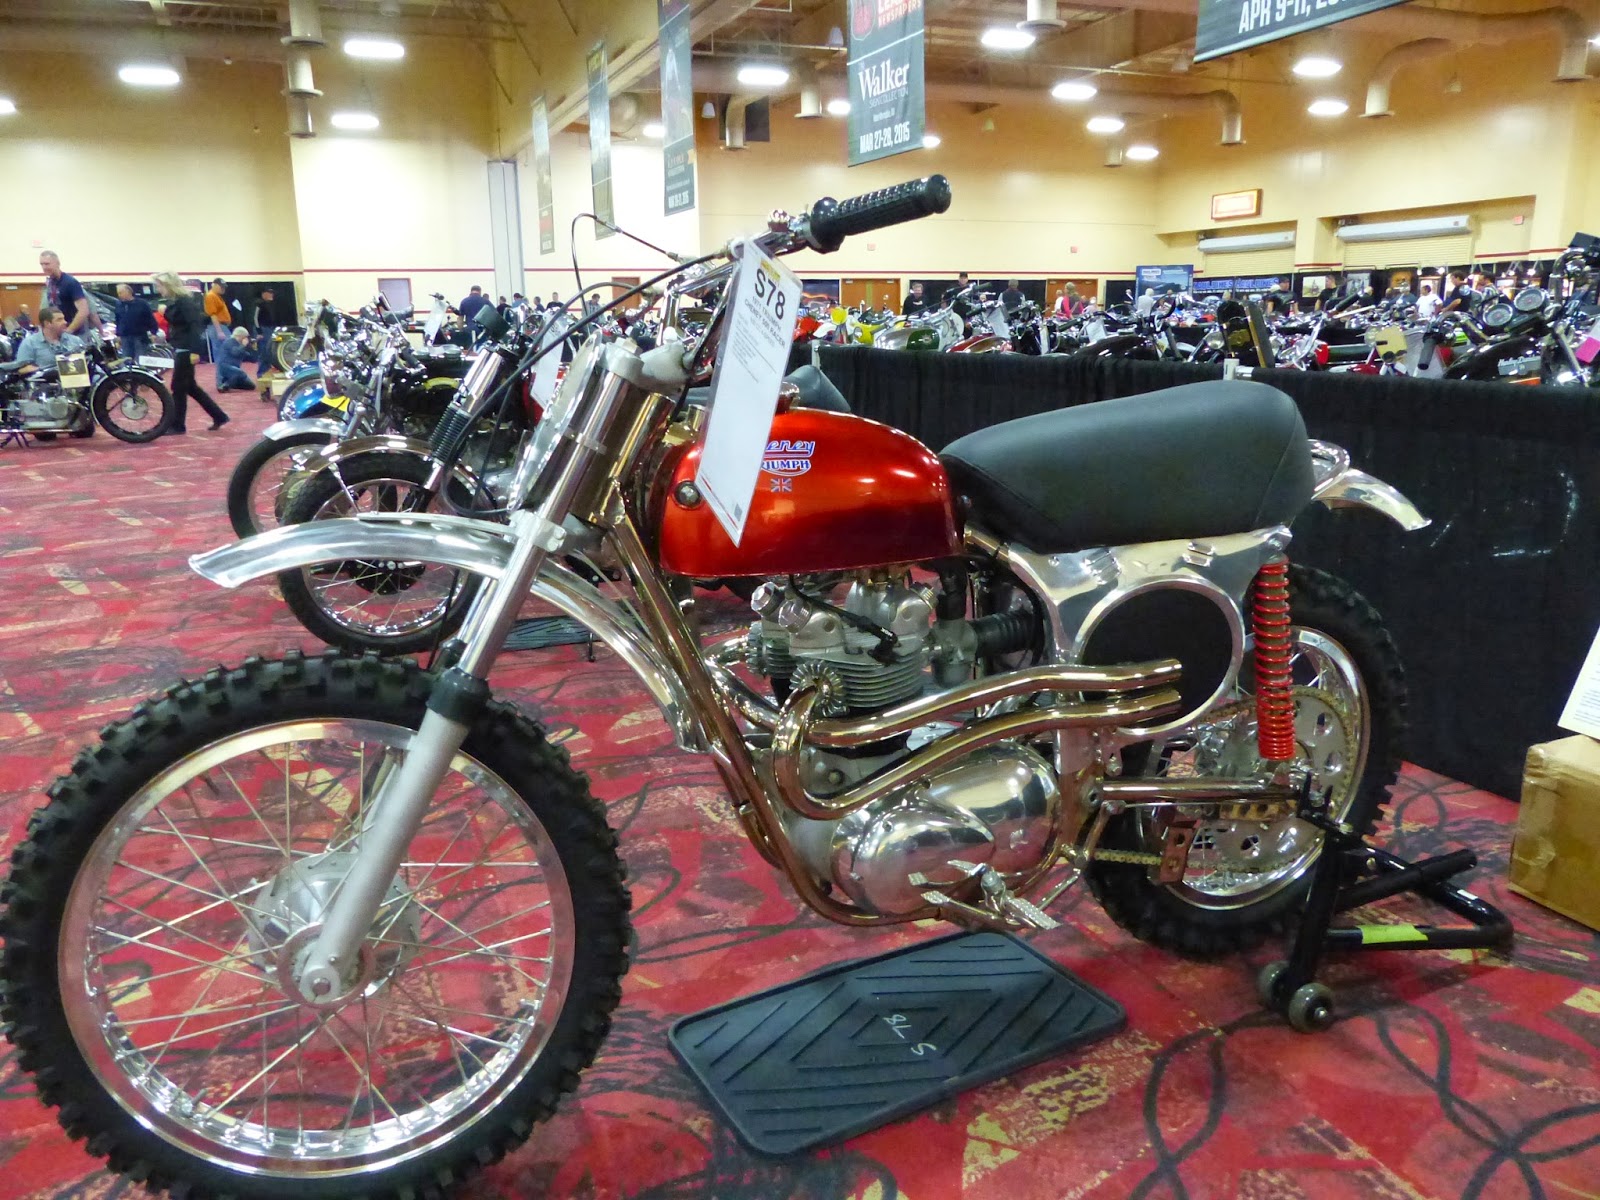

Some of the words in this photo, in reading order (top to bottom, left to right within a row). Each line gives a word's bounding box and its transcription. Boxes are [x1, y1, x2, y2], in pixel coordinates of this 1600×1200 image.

[1238, 0, 1271, 34] APR
[858, 59, 909, 100] Walker
[859, 134, 874, 154] MAR
[894, 121, 911, 145] 2015
[755, 268, 786, 320] S78
[745, 298, 762, 320] CHENEY
[769, 326, 786, 347] RACER
[766, 440, 816, 458] eney
